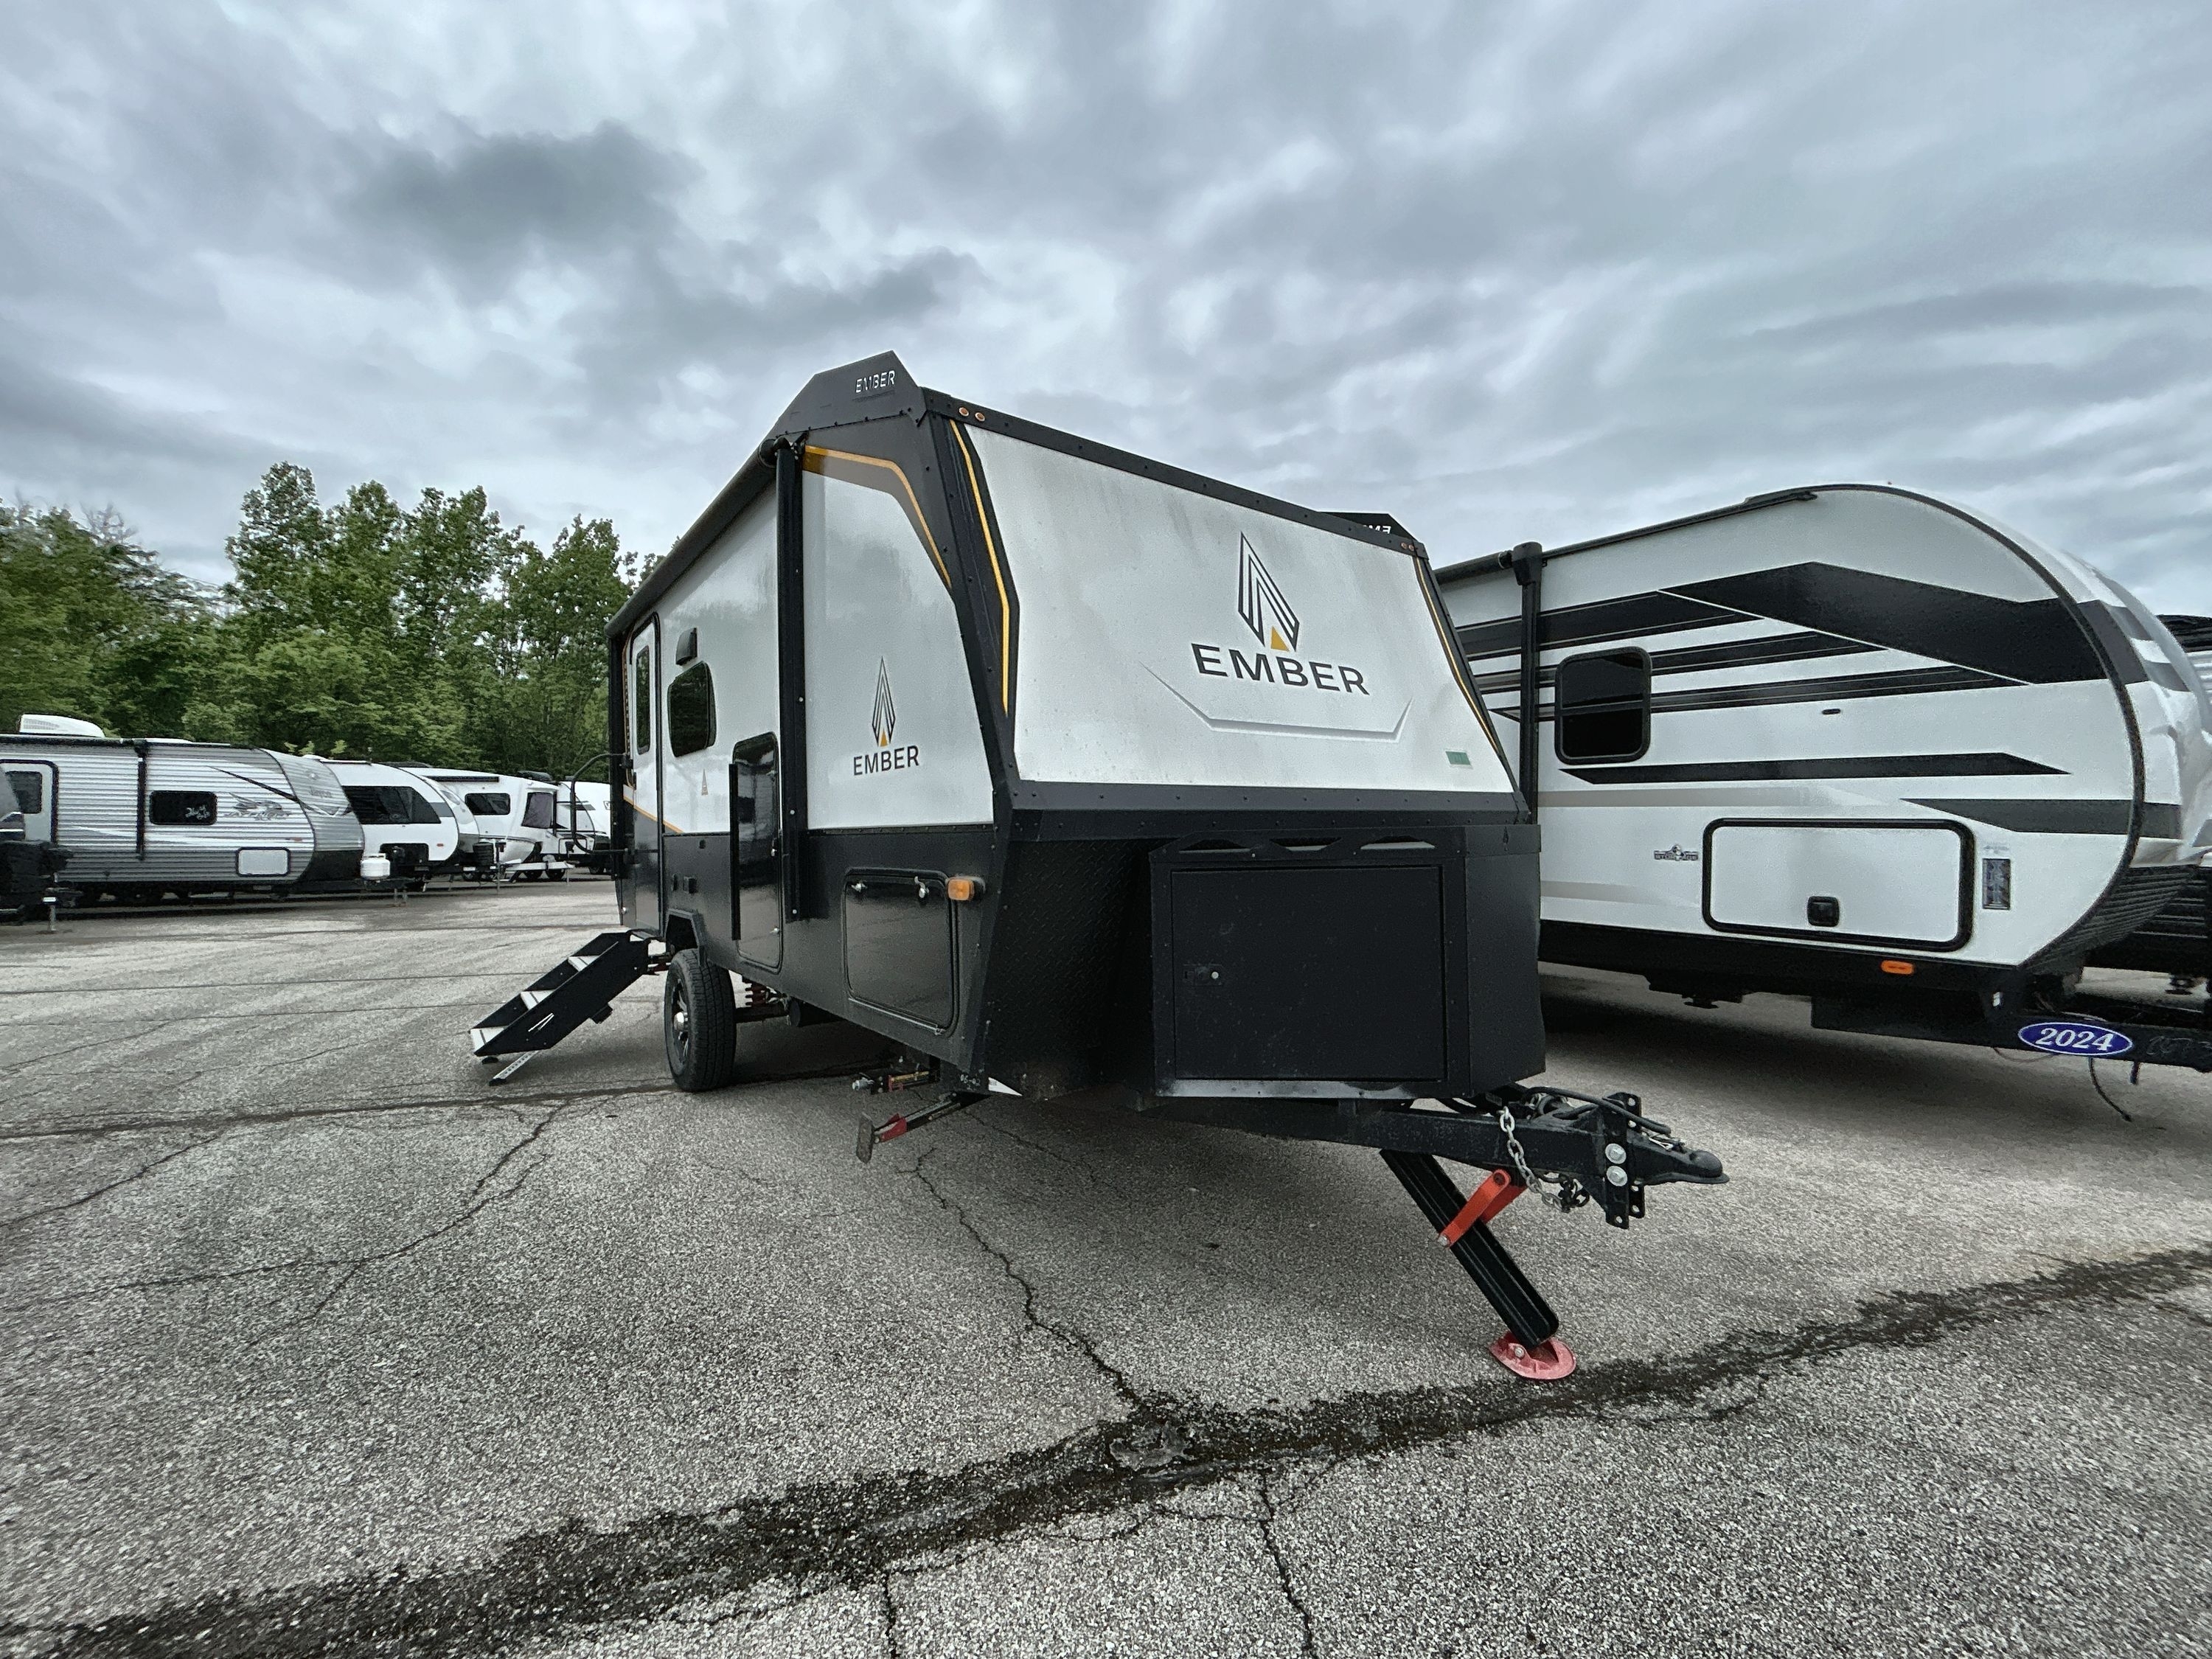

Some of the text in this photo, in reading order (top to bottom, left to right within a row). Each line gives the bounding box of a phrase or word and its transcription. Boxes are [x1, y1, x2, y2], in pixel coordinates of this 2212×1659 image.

[855, 370, 895, 393] EMBER
[1191, 643, 1370, 695] EMBER
[854, 745, 919, 776] EMBER
[2035, 1028, 2114, 1051] 2024
